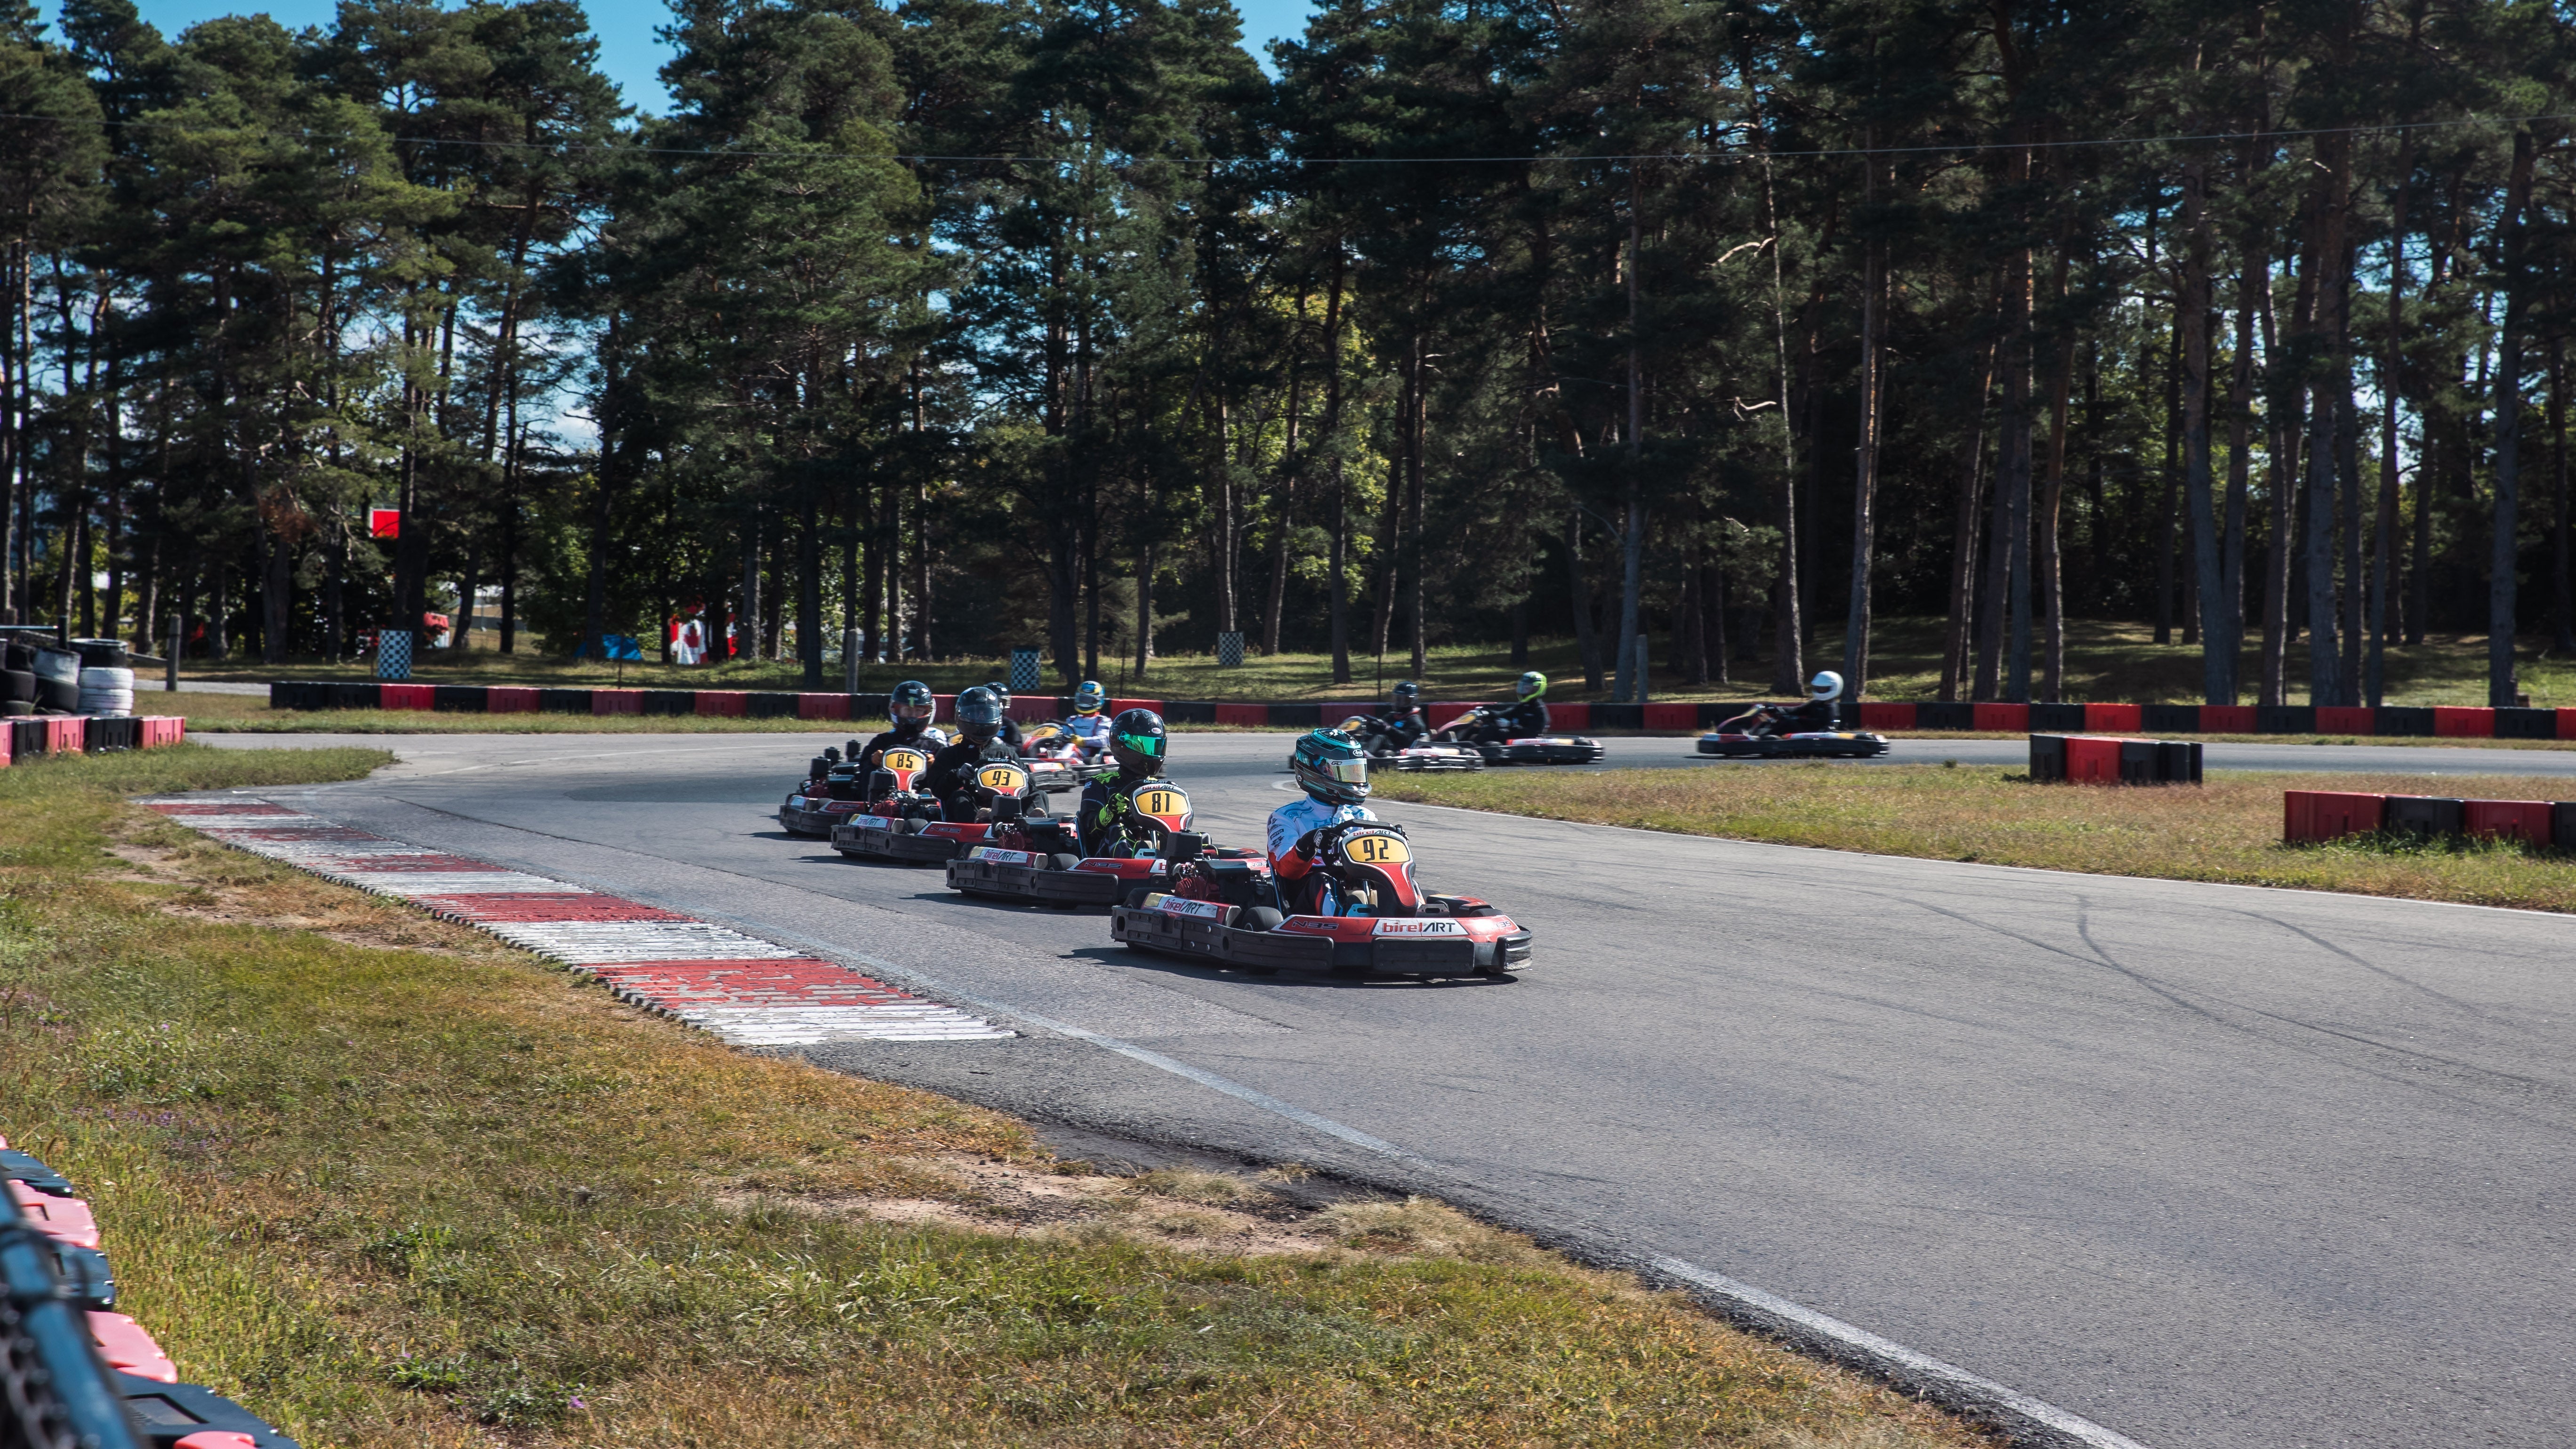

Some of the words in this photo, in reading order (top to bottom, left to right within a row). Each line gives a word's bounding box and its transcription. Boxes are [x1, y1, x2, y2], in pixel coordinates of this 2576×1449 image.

[897, 754, 914, 769] 85
[991, 771, 1011, 786] 93
[1152, 793, 1170, 813] 81
[984, 849, 1017, 861] birelART
[1363, 839, 1389, 861] 92
[1163, 898, 1205, 914] birelART
[1382, 922, 1456, 933] birelART
